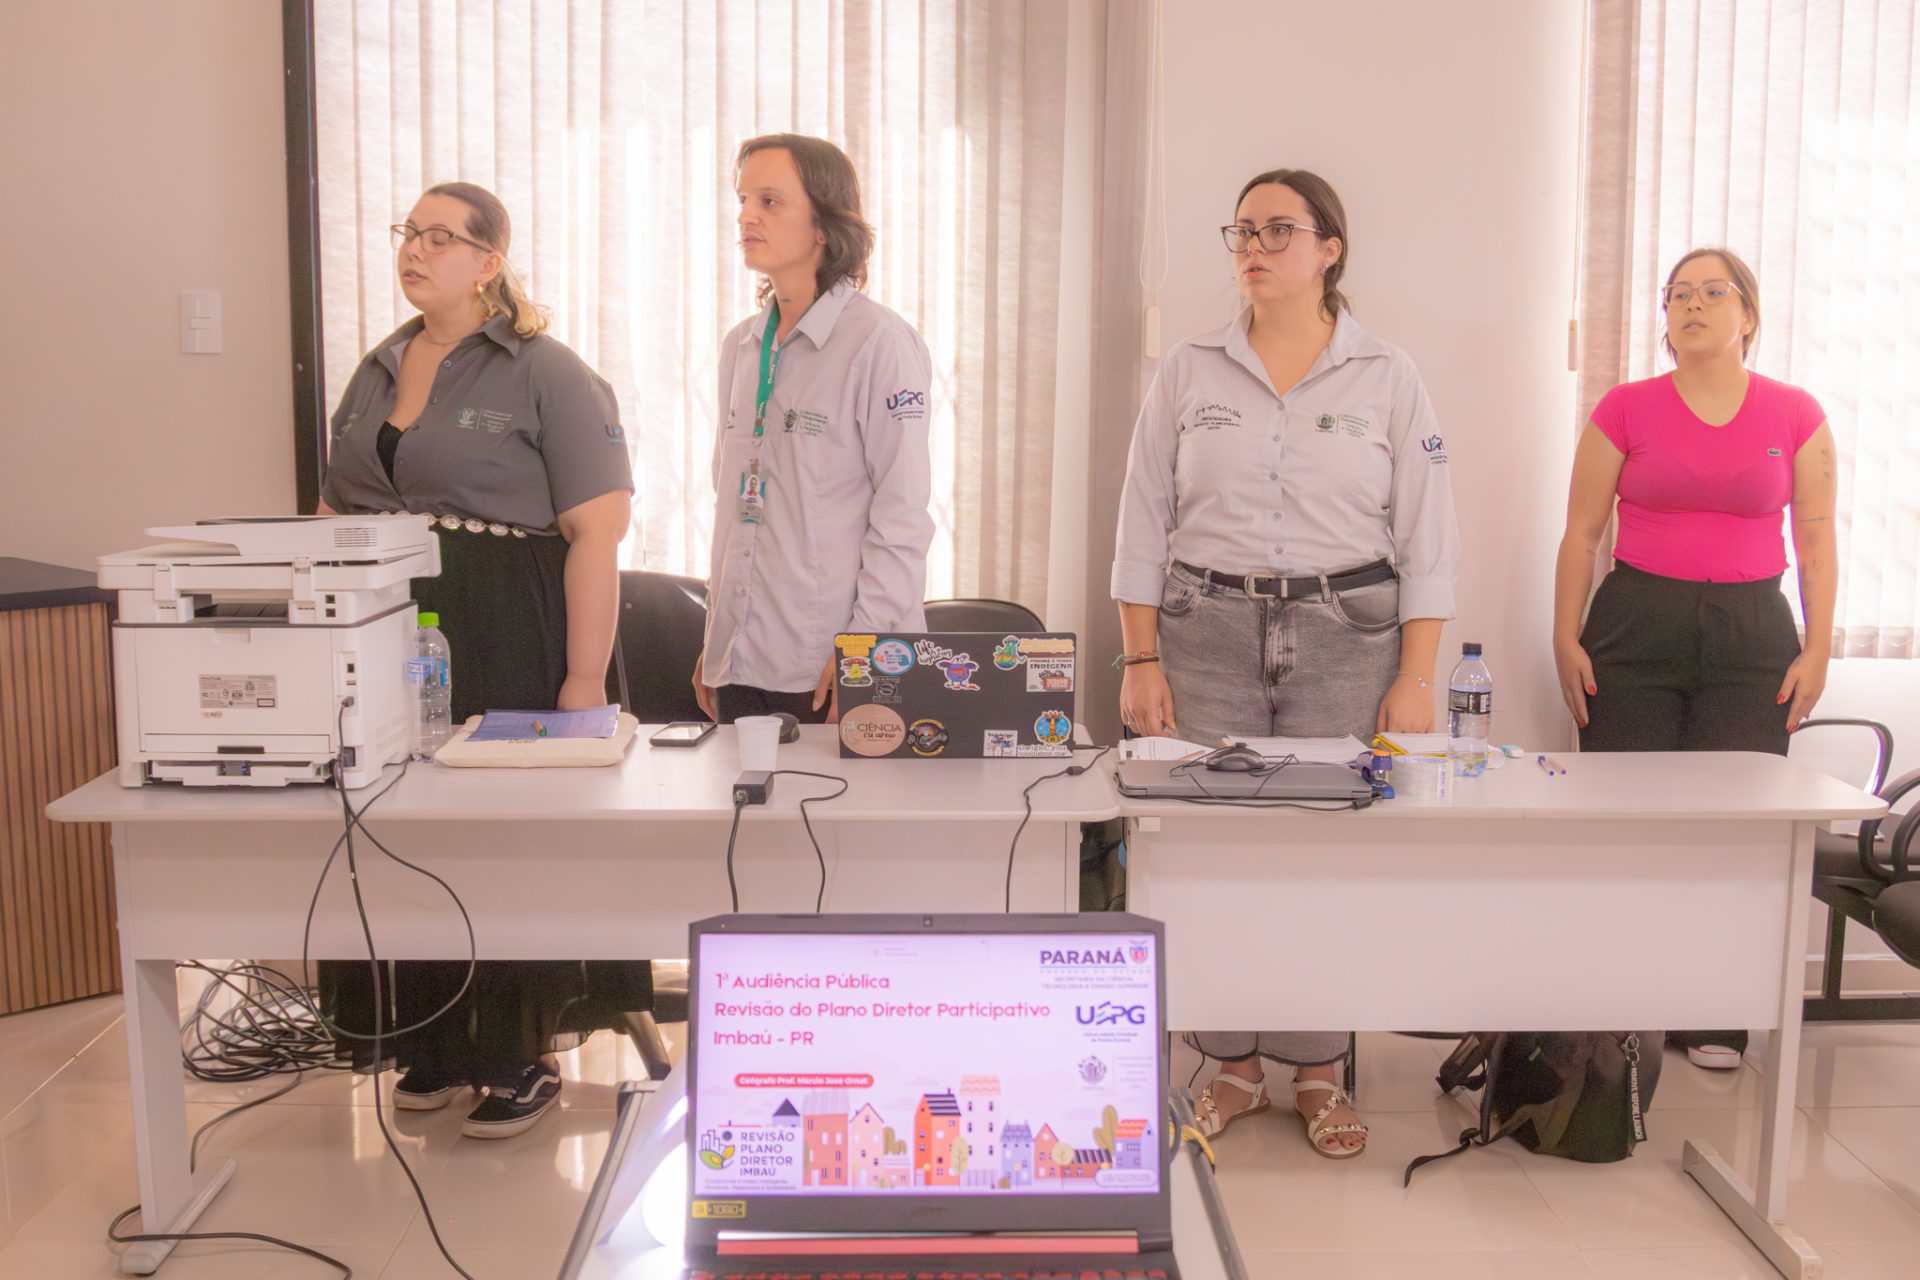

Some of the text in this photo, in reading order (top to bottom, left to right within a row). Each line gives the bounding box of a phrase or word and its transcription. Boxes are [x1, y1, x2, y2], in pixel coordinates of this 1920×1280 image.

[886, 389, 924, 410] UEPG
[857, 722, 902, 732] CIÊNCIA
[1040, 947, 1126, 964] PARANÁ
[733, 972, 820, 989] Audiência
[826, 973, 890, 989] Pública
[714, 1000, 1050, 1020] Revisão do Plano Diretor Participativo
[1075, 1001, 1145, 1025] UEPG
[714, 1029, 771, 1045] Imbaú
[790, 1031, 814, 1045] PR
[740, 1130, 795, 1142] REVISÃO
[740, 1144, 783, 1154] PLANO
[740, 1156, 793, 1166] DIRETOR
